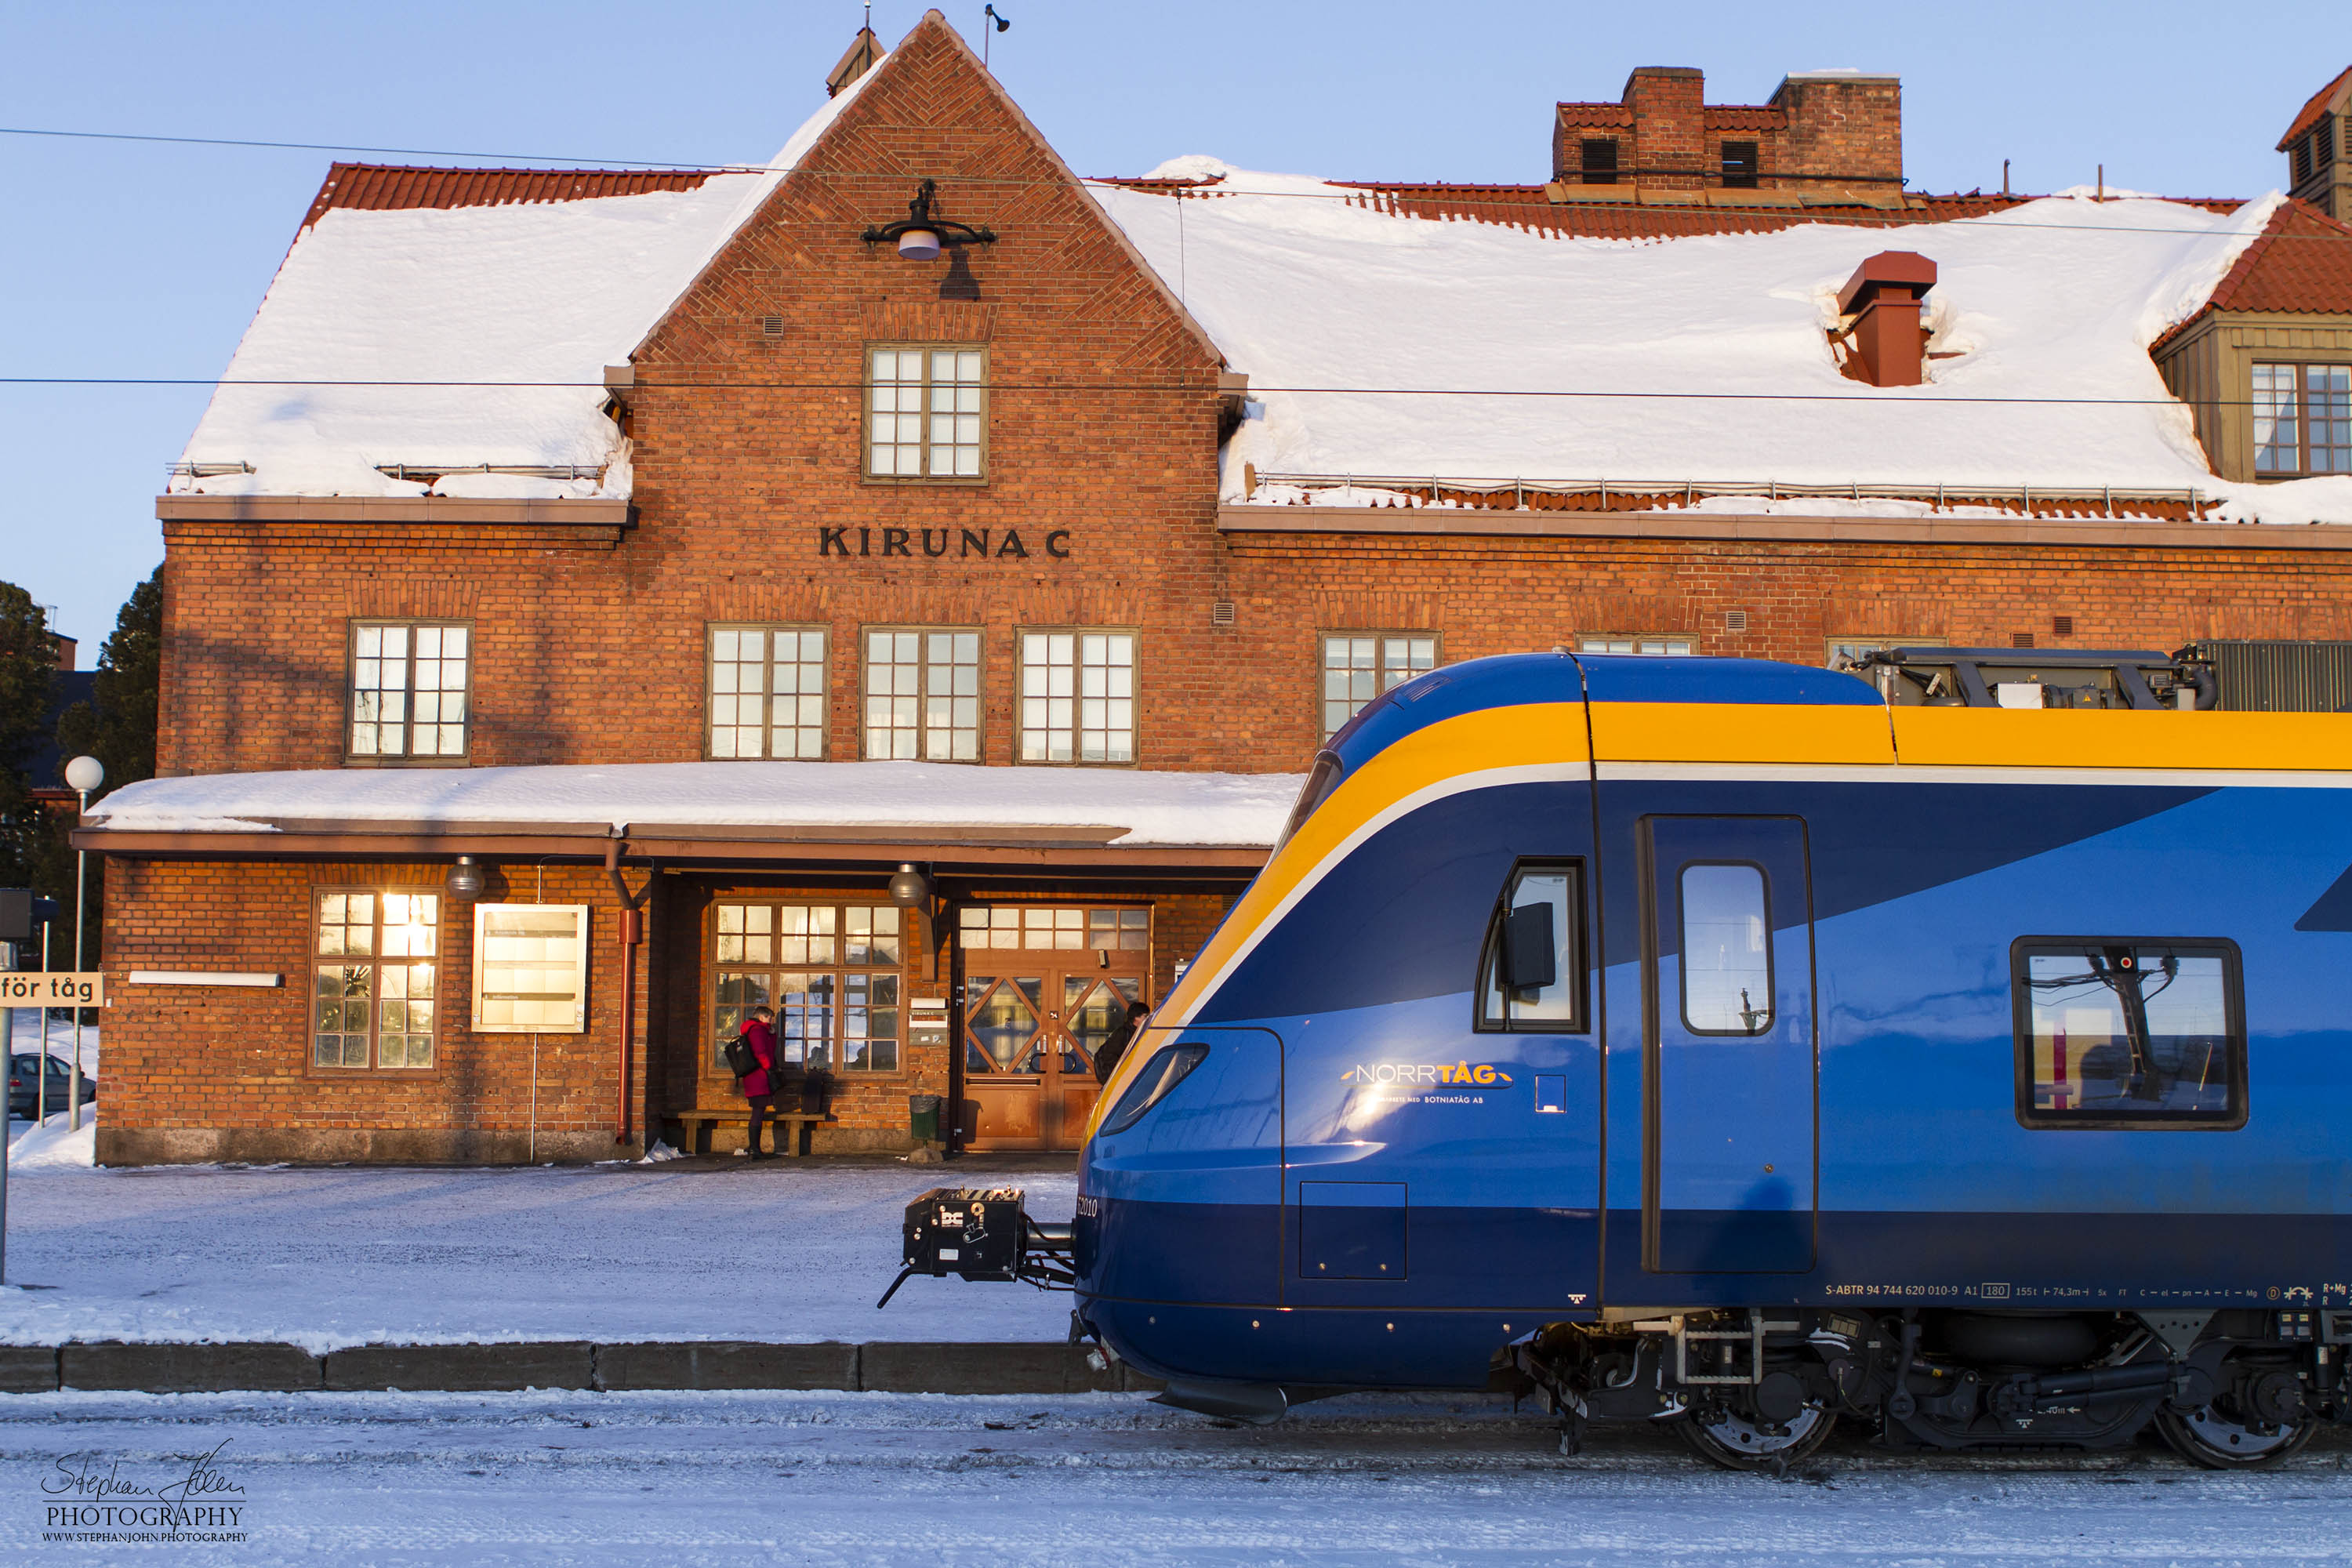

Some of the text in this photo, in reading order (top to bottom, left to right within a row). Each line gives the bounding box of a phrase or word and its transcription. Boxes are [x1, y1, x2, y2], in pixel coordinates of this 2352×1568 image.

[818, 527, 1070, 557] KIRUNA C
[2, 977, 93, 1002] för tåg
[1356, 1060, 1496, 1083] NORRTÅG
[1425, 1095, 1469, 1104] BOTNIATÅG
[1826, 1285, 1864, 1294] S-ABTR
[1867, 1286, 1879, 1294] 94
[1883, 1286, 1902, 1294] 744
[1905, 1286, 1925, 1295] 620
[1928, 1286, 1958, 1295] 010-9
[1964, 1286, 1977, 1295] A1
[1987, 1287, 2005, 1295] 180
